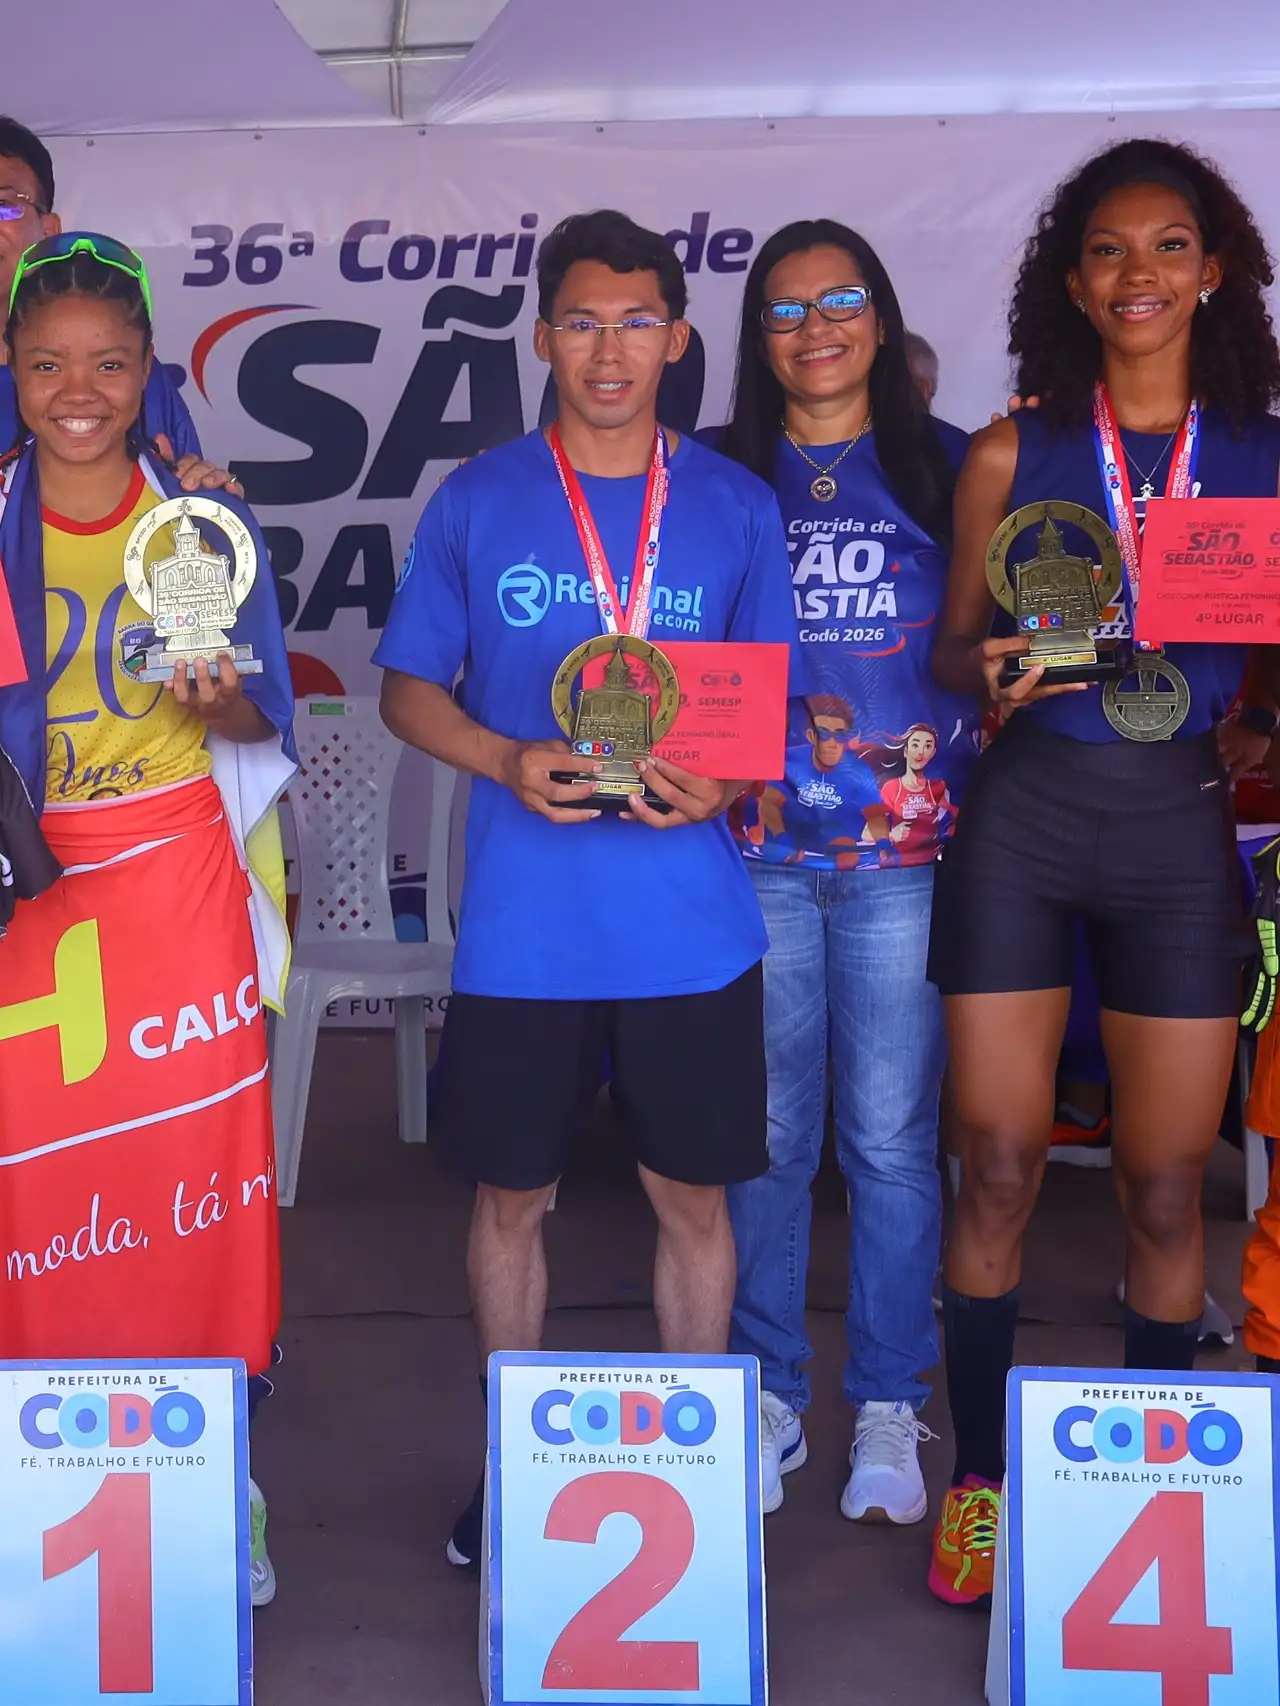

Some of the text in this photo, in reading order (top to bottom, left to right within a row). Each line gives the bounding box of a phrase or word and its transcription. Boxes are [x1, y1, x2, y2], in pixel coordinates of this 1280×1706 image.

[183, 220, 314, 287] 36ª
[339, 213, 539, 283] Corri
[788, 518, 897, 534] Corrida de
[1186, 529, 1241, 551] SÃO
[1163, 552, 1255, 566] SEBASTIÃO
[555, 573, 704, 618] Reinal
[1195, 612, 1265, 625] 4º LUGAR
[799, 628, 884, 642] Codó 2026
[697, 697, 742, 707] SEMESP
[326, 1001, 339, 1017] E
[7, 1193, 151, 1282] moda,
[171, 1172, 229, 1238] tá
[47, 1375, 167, 1387] PREFEITURA DE
[559, 1373, 678, 1384] PREFEITURA DE
[1082, 1389, 1204, 1402] PREFEITURA DE
[19, 1385, 206, 1450] CODÓ
[531, 1384, 717, 1447] CODÓ
[1053, 1402, 1243, 1466] CODÓ
[21, 1454, 206, 1469] FÉ, TRABALHO E FUTURO
[532, 1451, 717, 1466] FÉ, TRABALHO E FUTURO
[1054, 1468, 1243, 1487] FÉ, TRABALHO E FUTURO
[42, 1472, 154, 1694] 1
[541, 1470, 701, 1691] 2
[1062, 1490, 1234, 1706] 4
